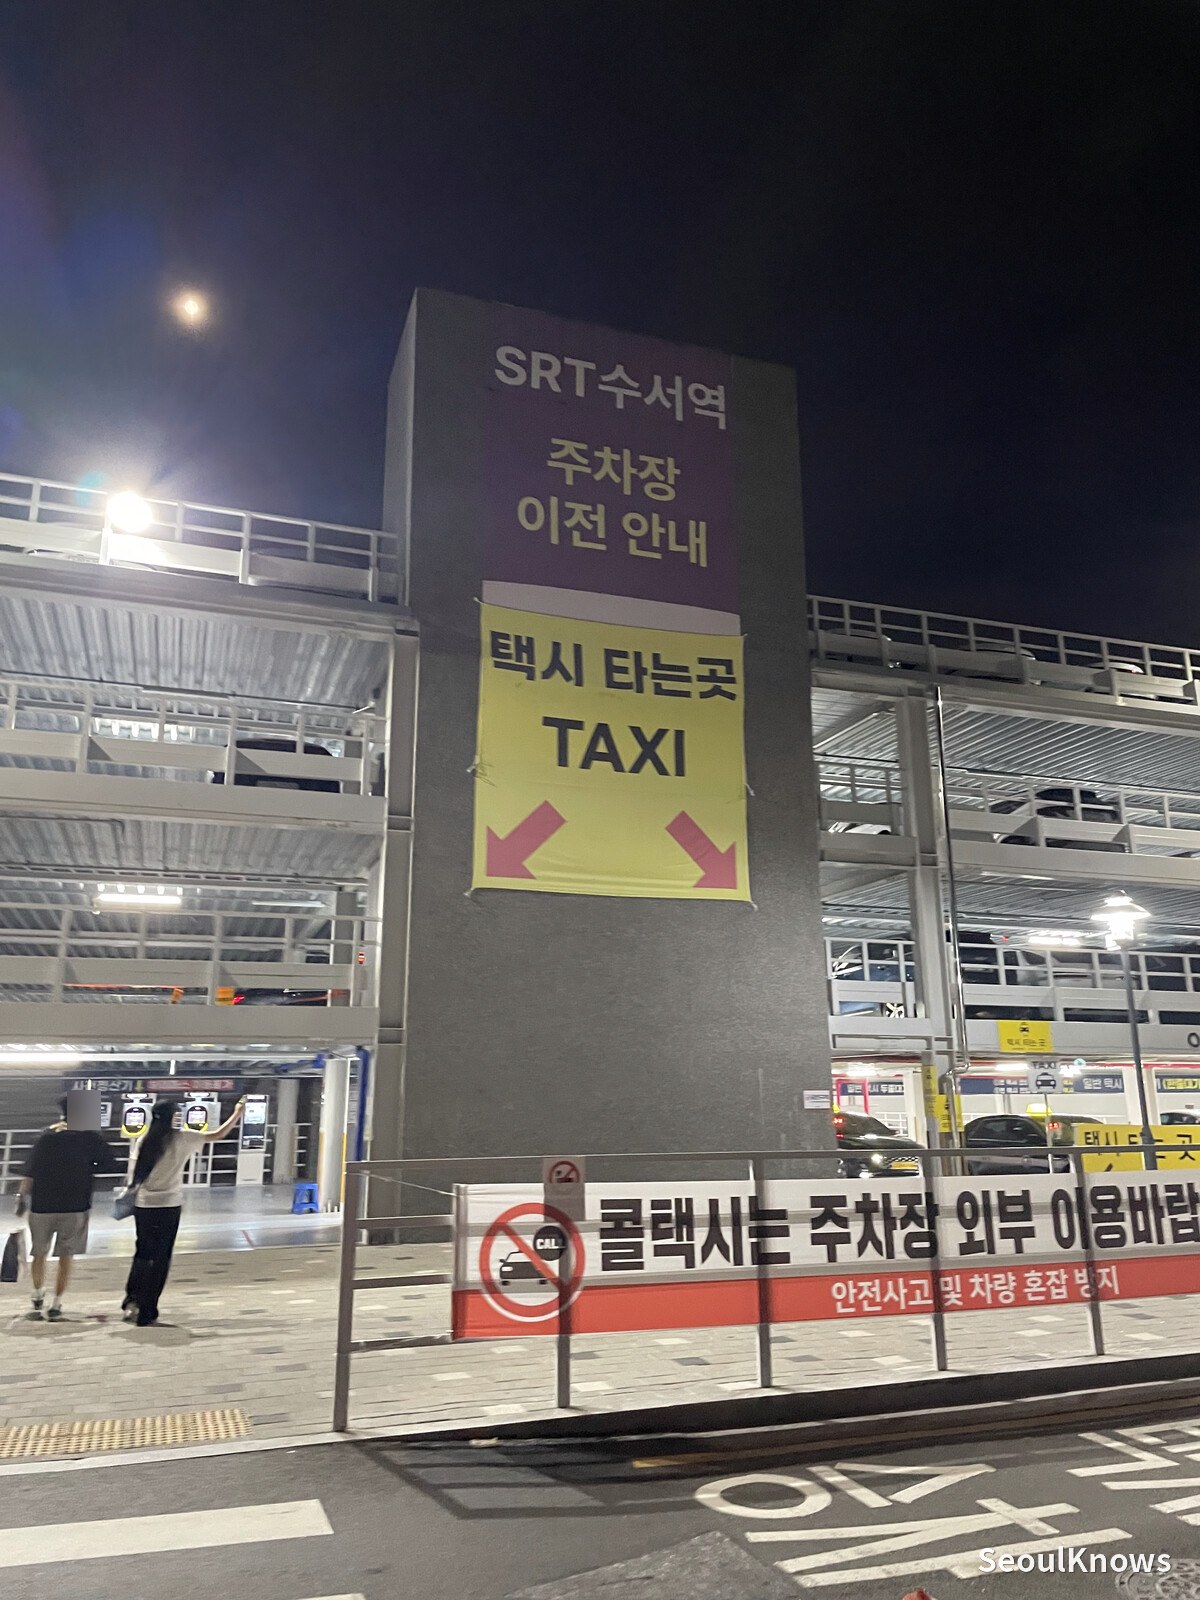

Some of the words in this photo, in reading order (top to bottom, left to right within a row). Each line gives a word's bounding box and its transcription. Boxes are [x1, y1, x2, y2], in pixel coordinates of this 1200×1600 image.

[495, 345, 726, 430] SRT수서역
[547, 437, 681, 502] 주차장
[517, 495, 607, 550] 이전
[622, 511, 708, 568] 안내
[490, 630, 584, 688] 택시
[603, 648, 737, 701] 타는곳
[542, 715, 686, 777] TAXI
[1032, 1060, 1057, 1069] TAXI
[599, 1195, 791, 1272] 콜택시는
[810, 1191, 938, 1262] 주차장
[956, 1189, 1036, 1256] 외부
[831, 1278, 934, 1314] 안전사고
[940, 1275, 964, 1307] 및
[969, 1269, 1017, 1305] 차량
[1023, 1267, 1069, 1302] 혼잡
[1073, 1264, 1121, 1299] 방지
